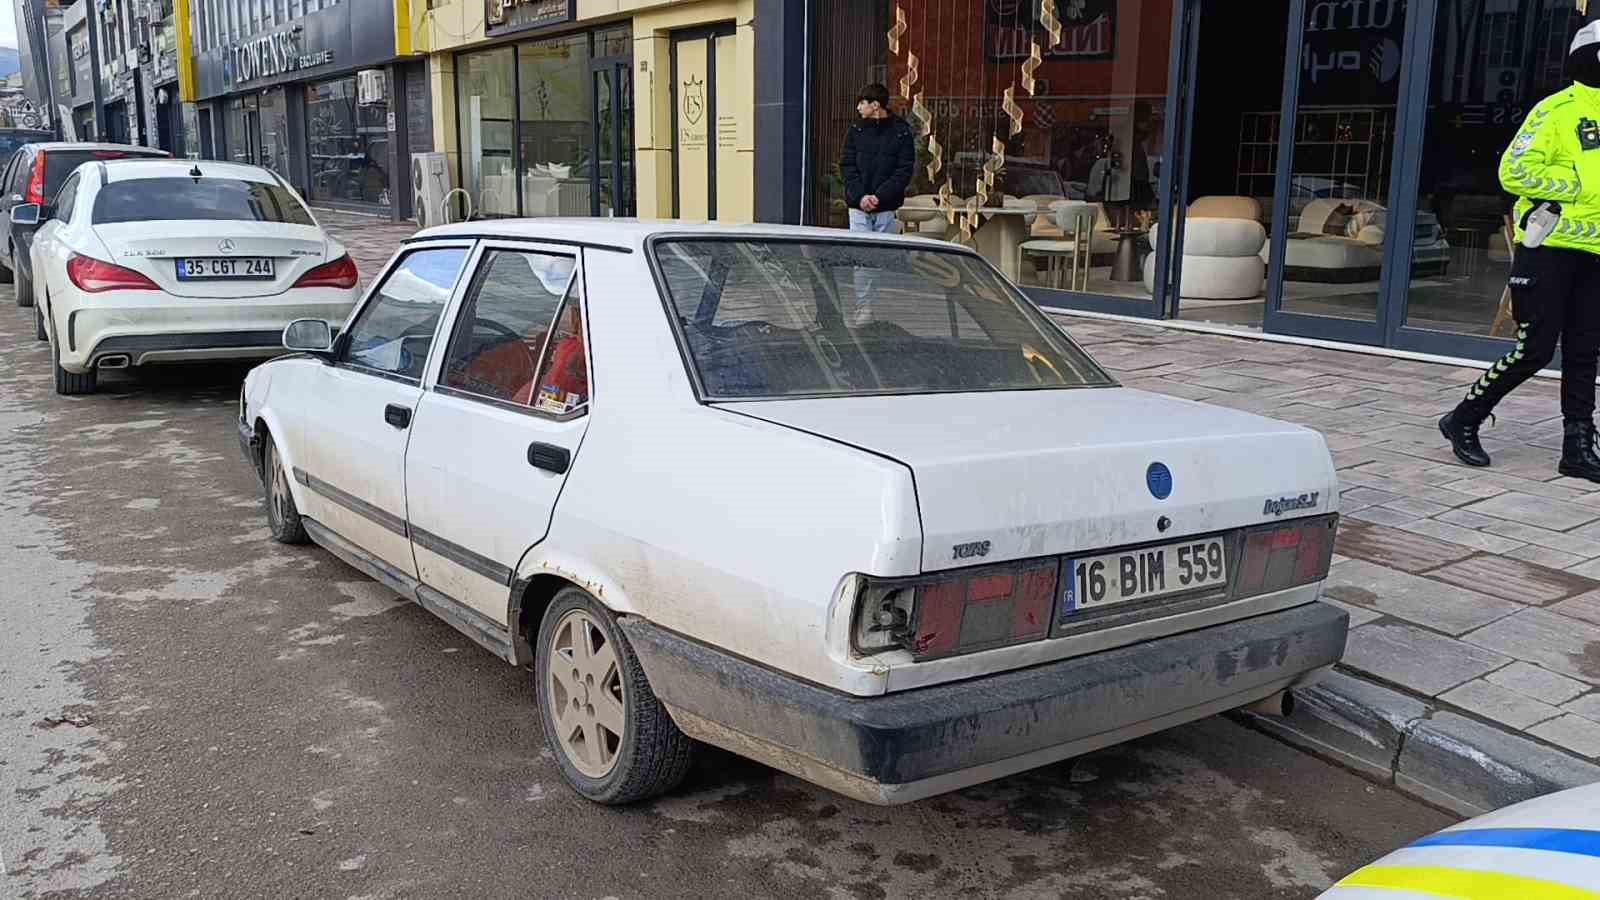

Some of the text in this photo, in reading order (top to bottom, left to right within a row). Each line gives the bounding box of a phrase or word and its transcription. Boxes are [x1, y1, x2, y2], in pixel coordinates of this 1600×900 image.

[234, 31, 288, 82] LOWENS
[186, 260, 271, 275] 35 CGT 244
[1076, 542, 1223, 604] 16 BIM 559
